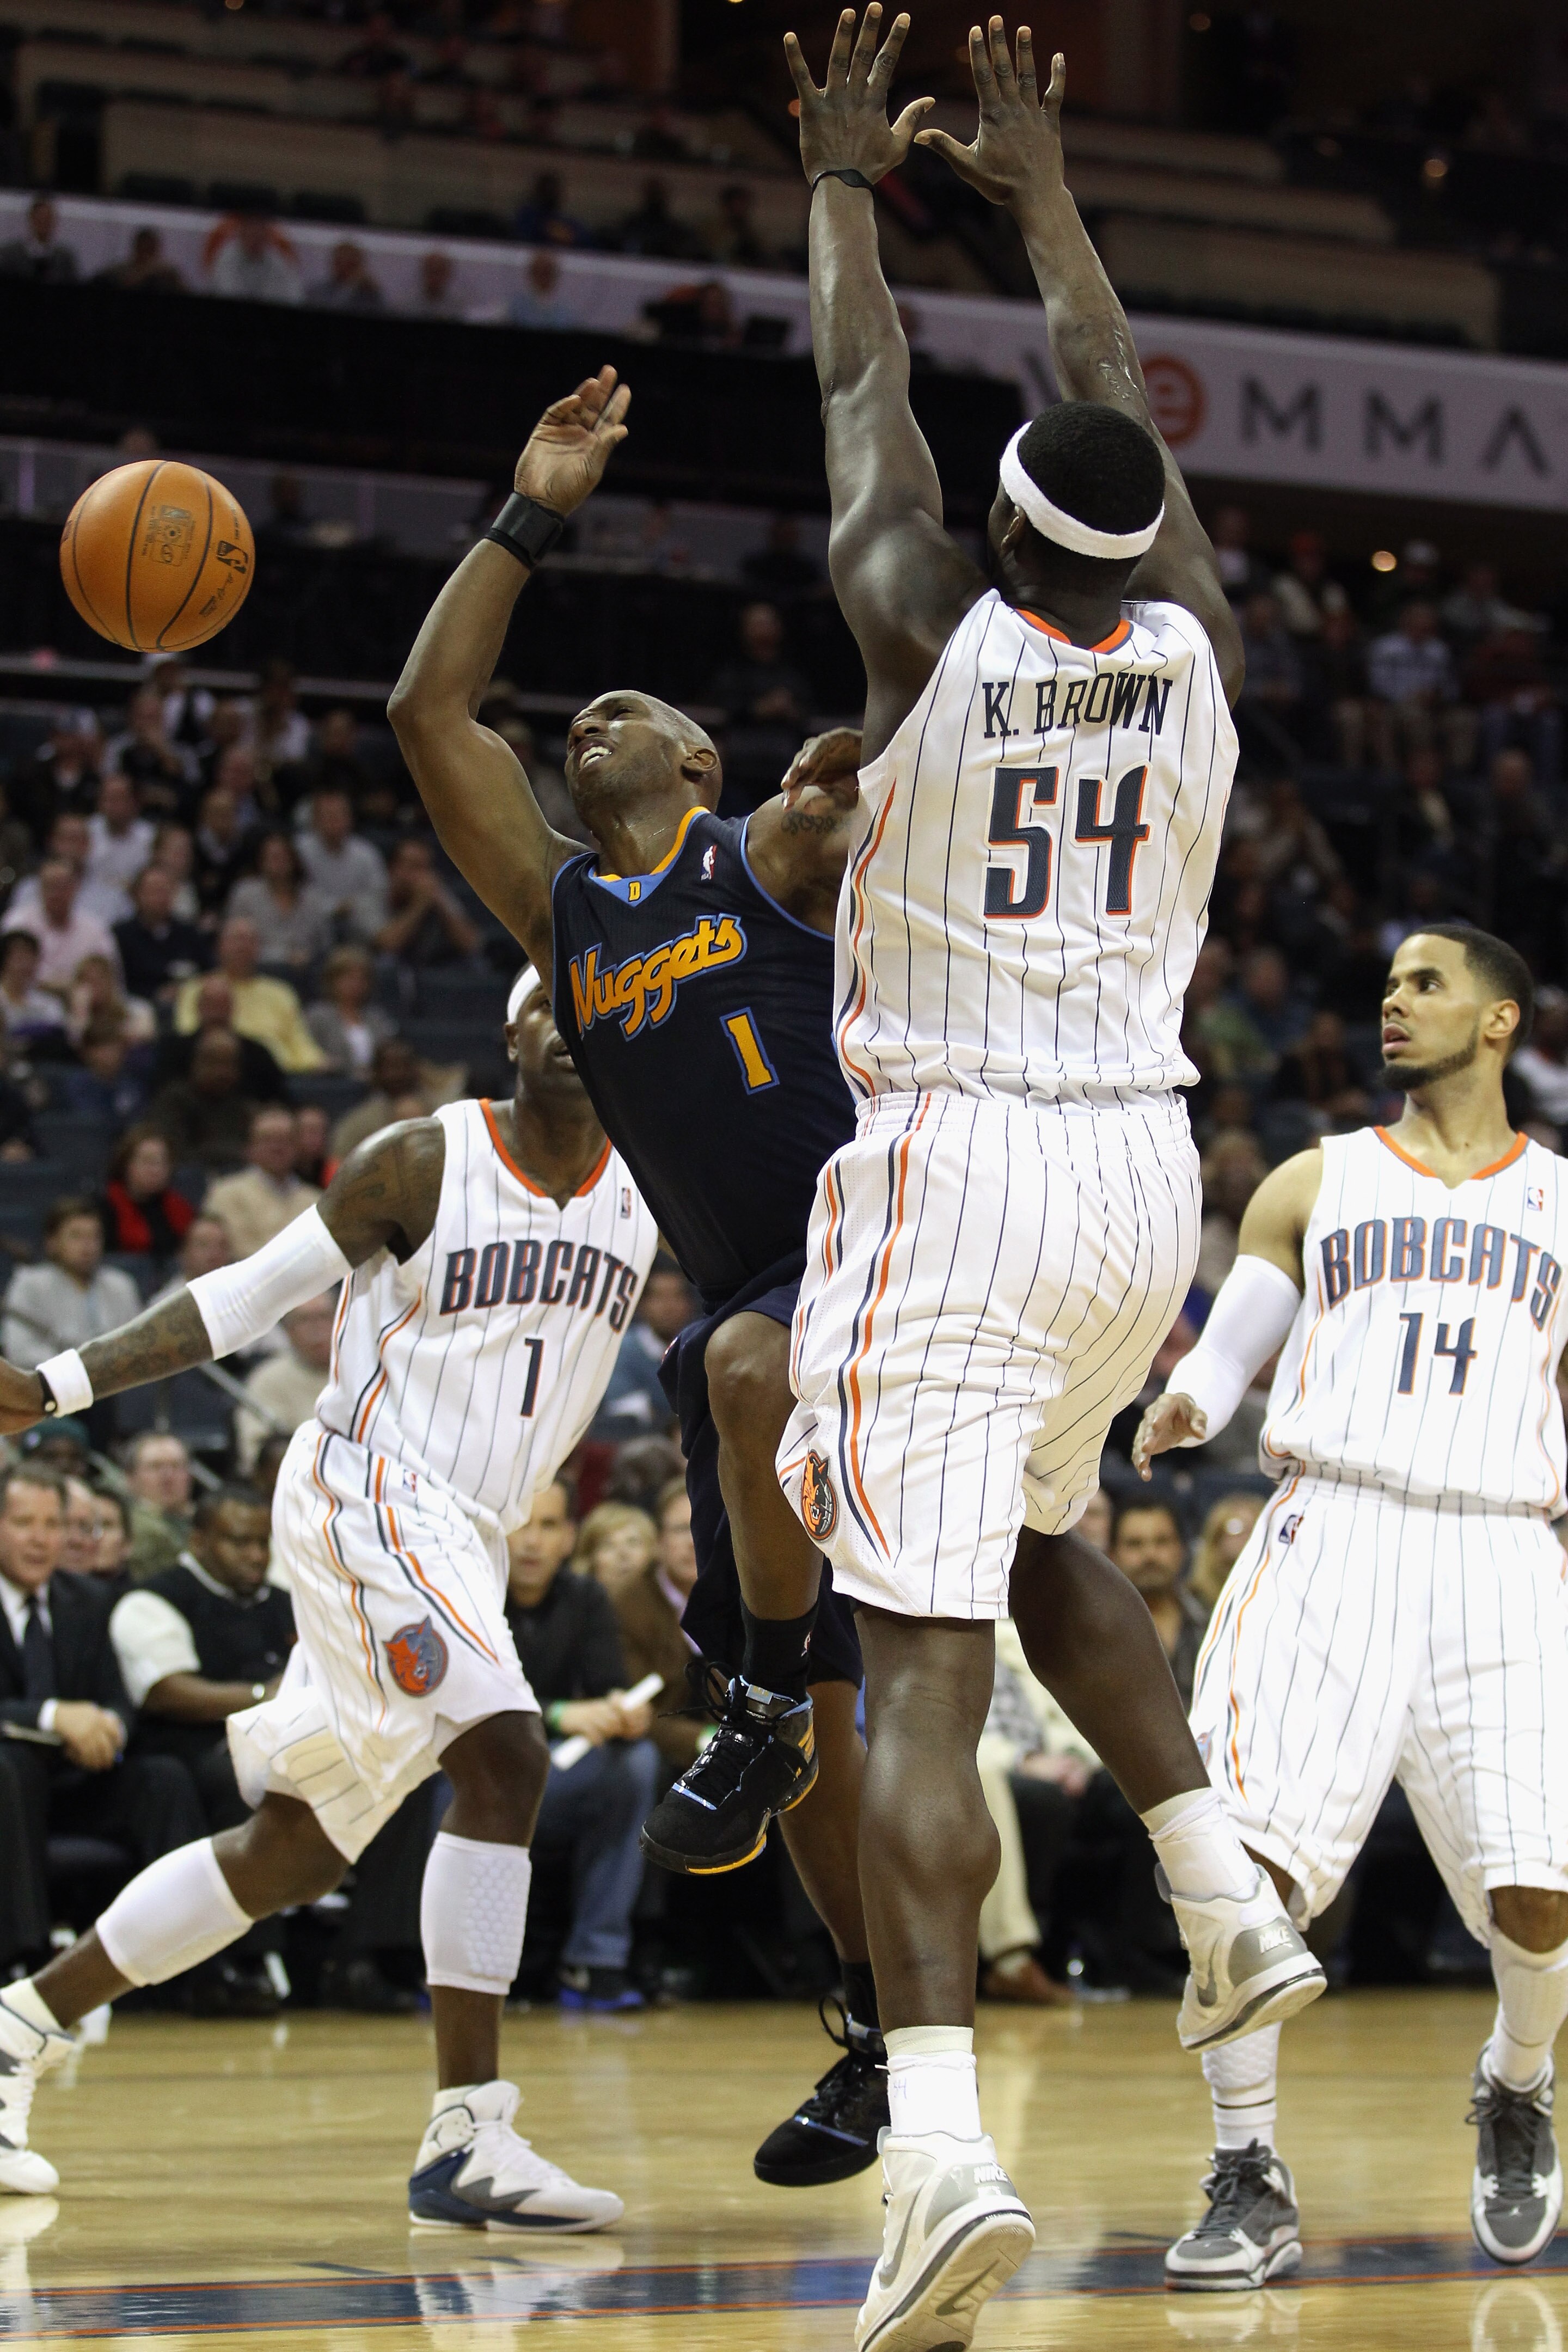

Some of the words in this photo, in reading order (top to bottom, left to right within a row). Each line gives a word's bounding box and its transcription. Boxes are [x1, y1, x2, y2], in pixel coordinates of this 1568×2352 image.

[982, 681, 1020, 739] K.
[1033, 671, 1174, 736] BROWN
[981, 762, 1153, 921] 54
[628, 881, 641, 902] D
[569, 912, 748, 1042] Nuggets
[720, 1006, 780, 1095] 1
[439, 1239, 638, 1334] BOBCATS
[1320, 1216, 1563, 1333] BOBCATS
[520, 1337, 544, 1418] 1
[1397, 1312, 1478, 1395] 14
[1257, 1925, 1291, 1954] NIKE
[973, 2163, 1009, 2184] NIKE
